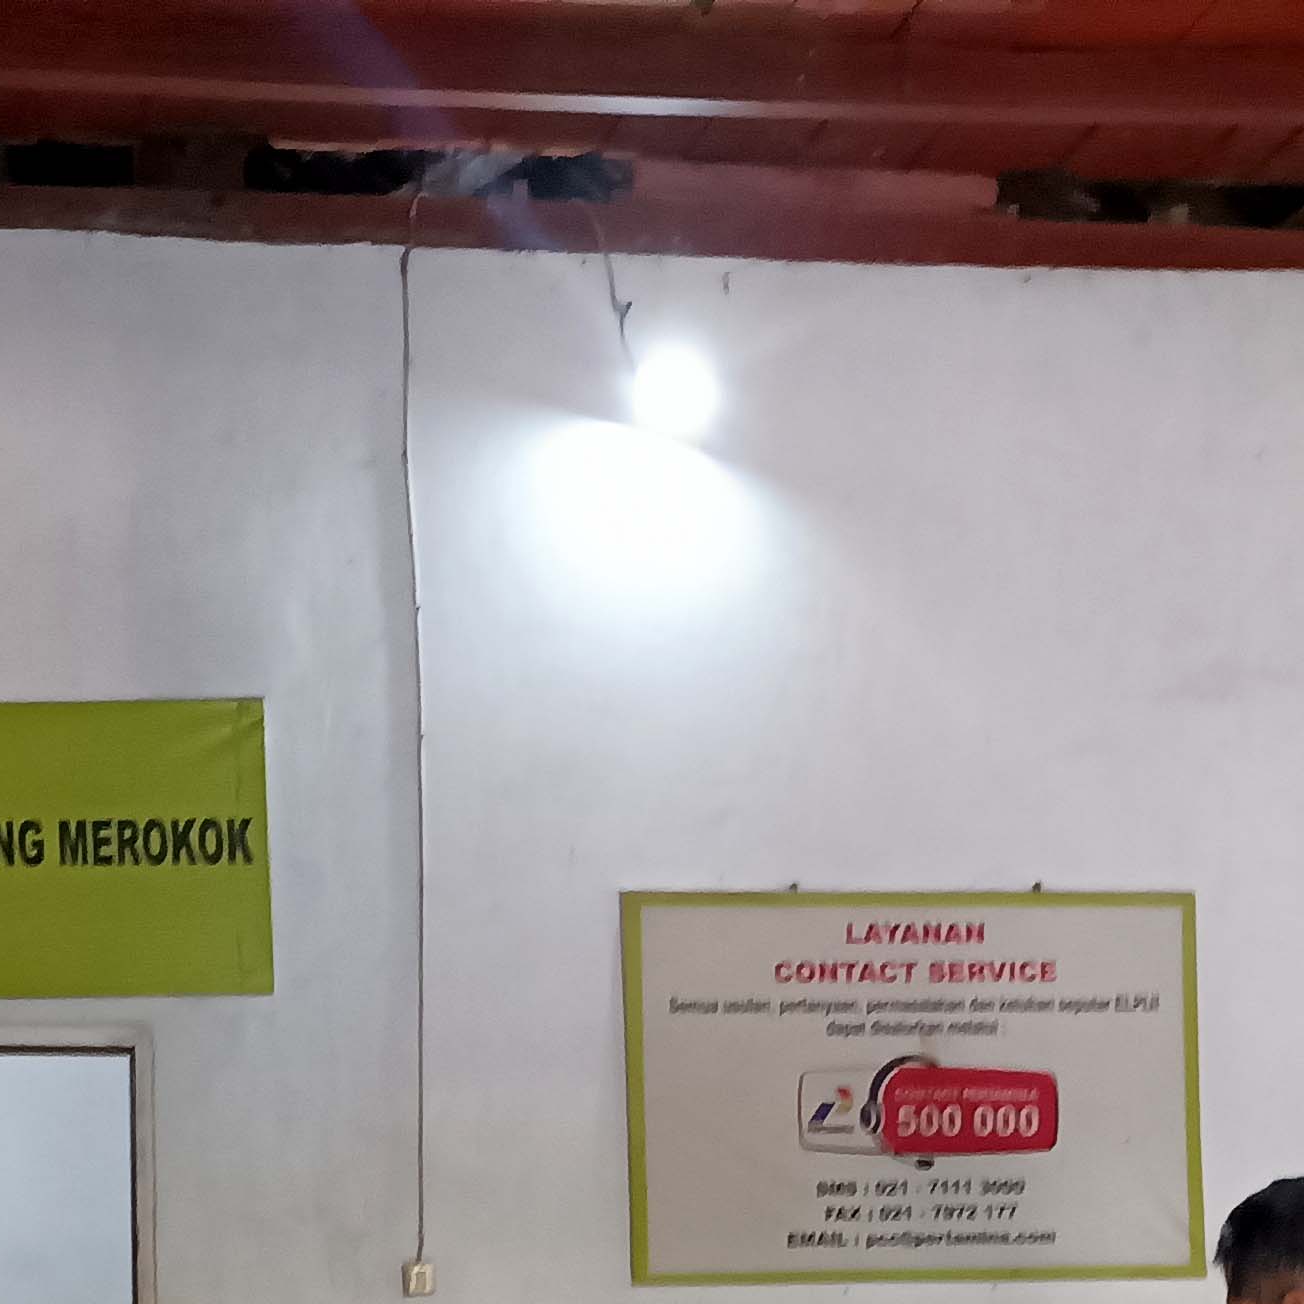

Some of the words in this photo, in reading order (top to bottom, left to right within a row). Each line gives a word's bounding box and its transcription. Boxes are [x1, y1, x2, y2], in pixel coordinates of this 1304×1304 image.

[57, 815, 254, 868] MEROKOK
[845, 921, 986, 946] LAYANAN
[774, 961, 917, 985] CONTACT
[928, 961, 1057, 984] SERVICE
[898, 1104, 962, 1137] 500
[973, 1104, 1040, 1137] 000
